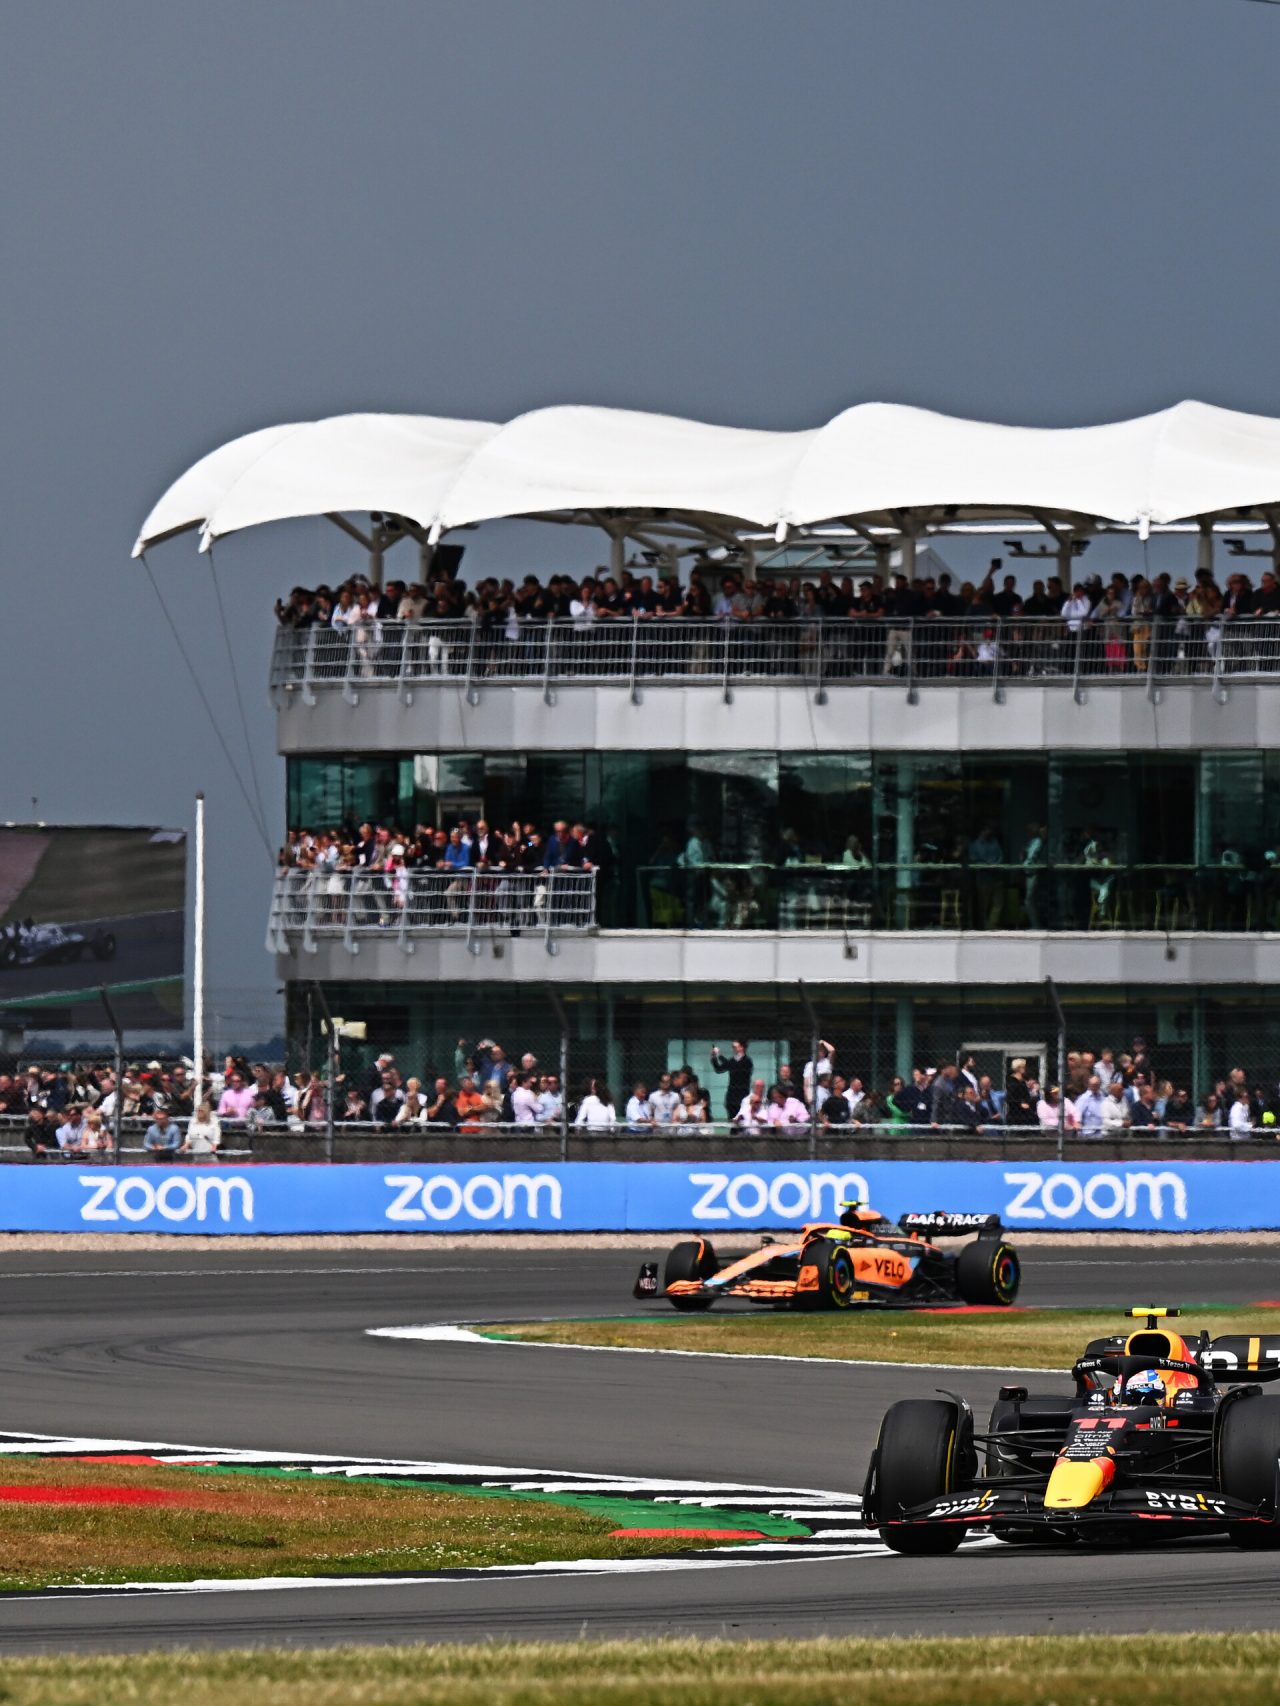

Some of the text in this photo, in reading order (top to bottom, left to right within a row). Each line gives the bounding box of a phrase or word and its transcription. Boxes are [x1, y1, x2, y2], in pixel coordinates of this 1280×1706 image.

[78, 1175, 254, 1222] zoom
[383, 1174, 562, 1221] zoom
[688, 1172, 869, 1220] zoom
[1003, 1172, 1188, 1220] zoom
[874, 1257, 905, 1279] VELO
[1072, 1417, 1127, 1429] 11
